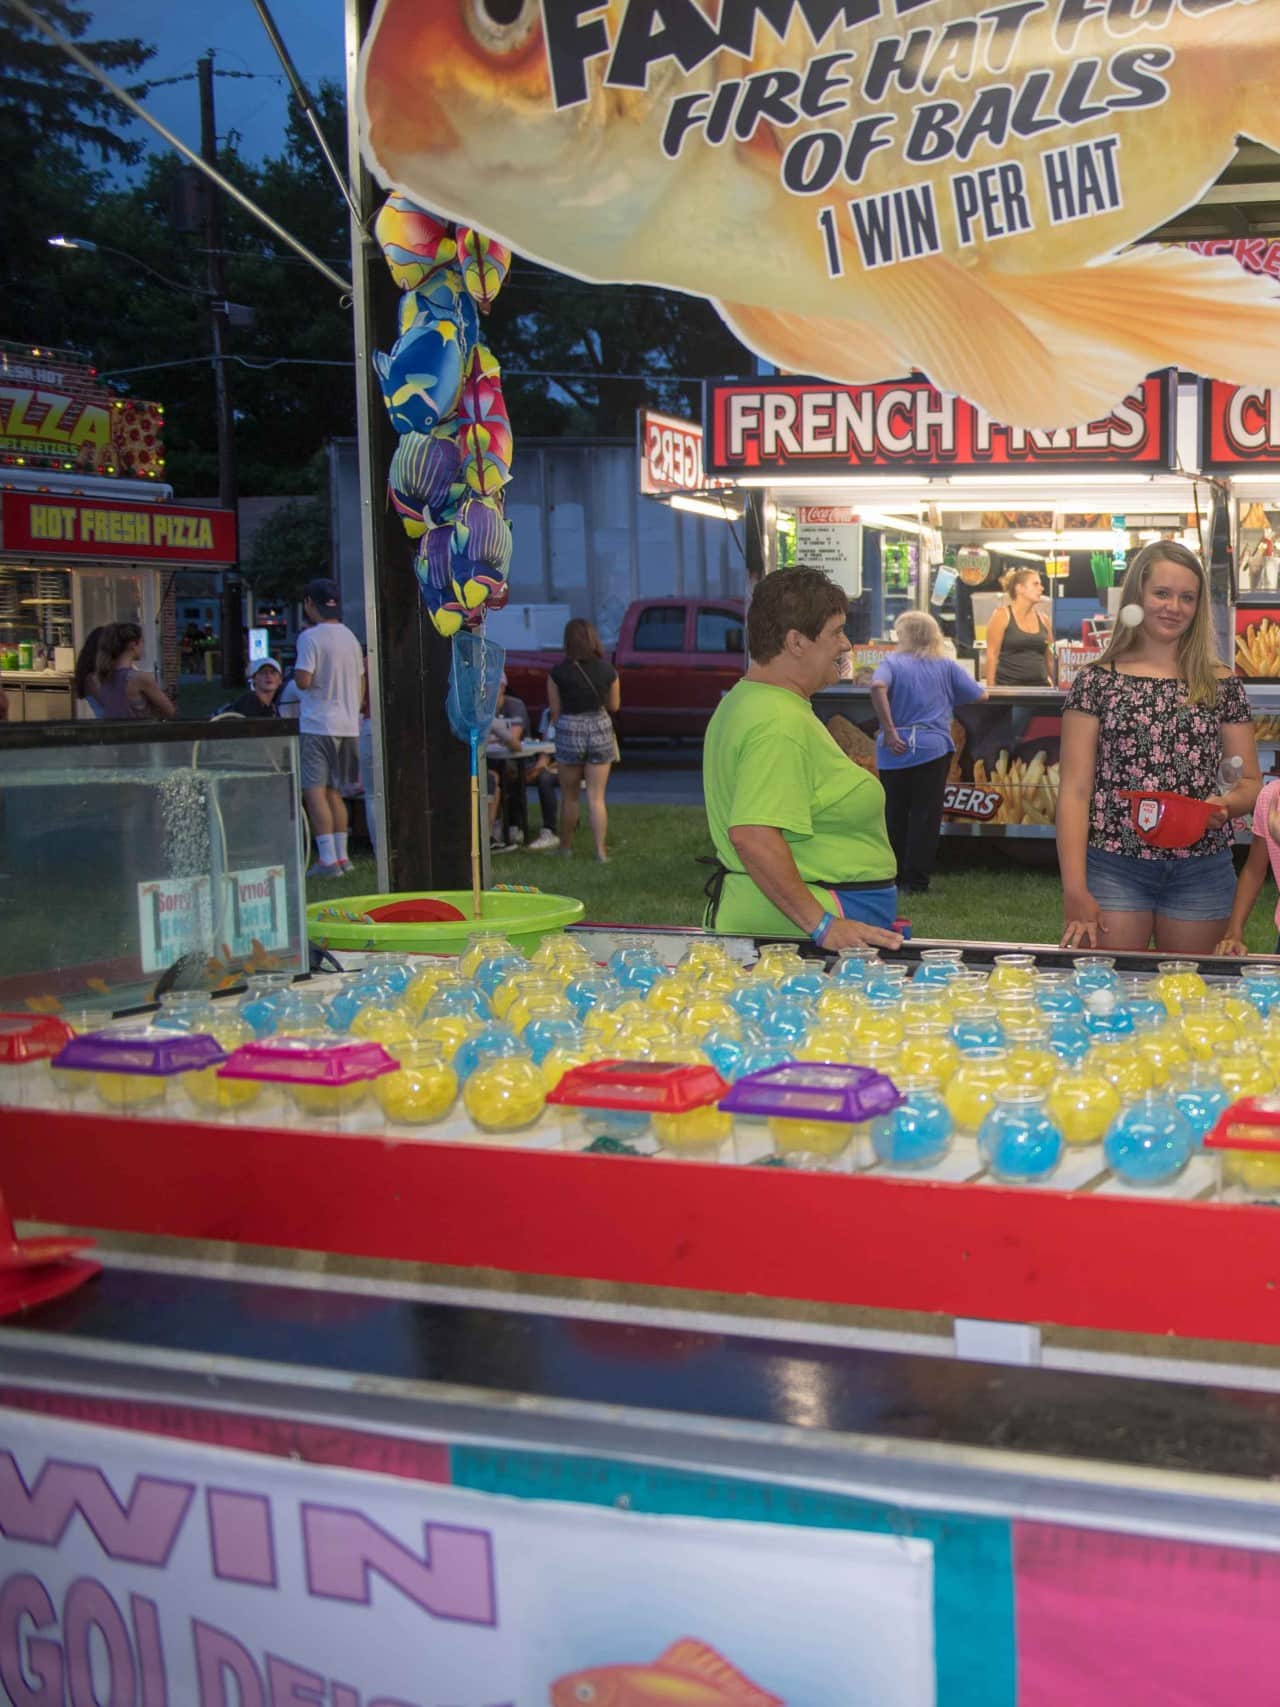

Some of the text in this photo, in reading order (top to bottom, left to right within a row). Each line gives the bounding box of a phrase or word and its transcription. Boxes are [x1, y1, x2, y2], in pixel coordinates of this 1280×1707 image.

[661, 52, 855, 158] FIRE
[864, 1, 1046, 99] HAT
[784, 48, 1173, 193] OF BALLS
[820, 138, 1120, 277] 1 WIN PER HAT
[0, 387, 112, 450] ZZA
[730, 390, 953, 455] FRENCH
[30, 504, 214, 549] HOT FRESH PIZZA
[0, 1448, 498, 1628] WIN
